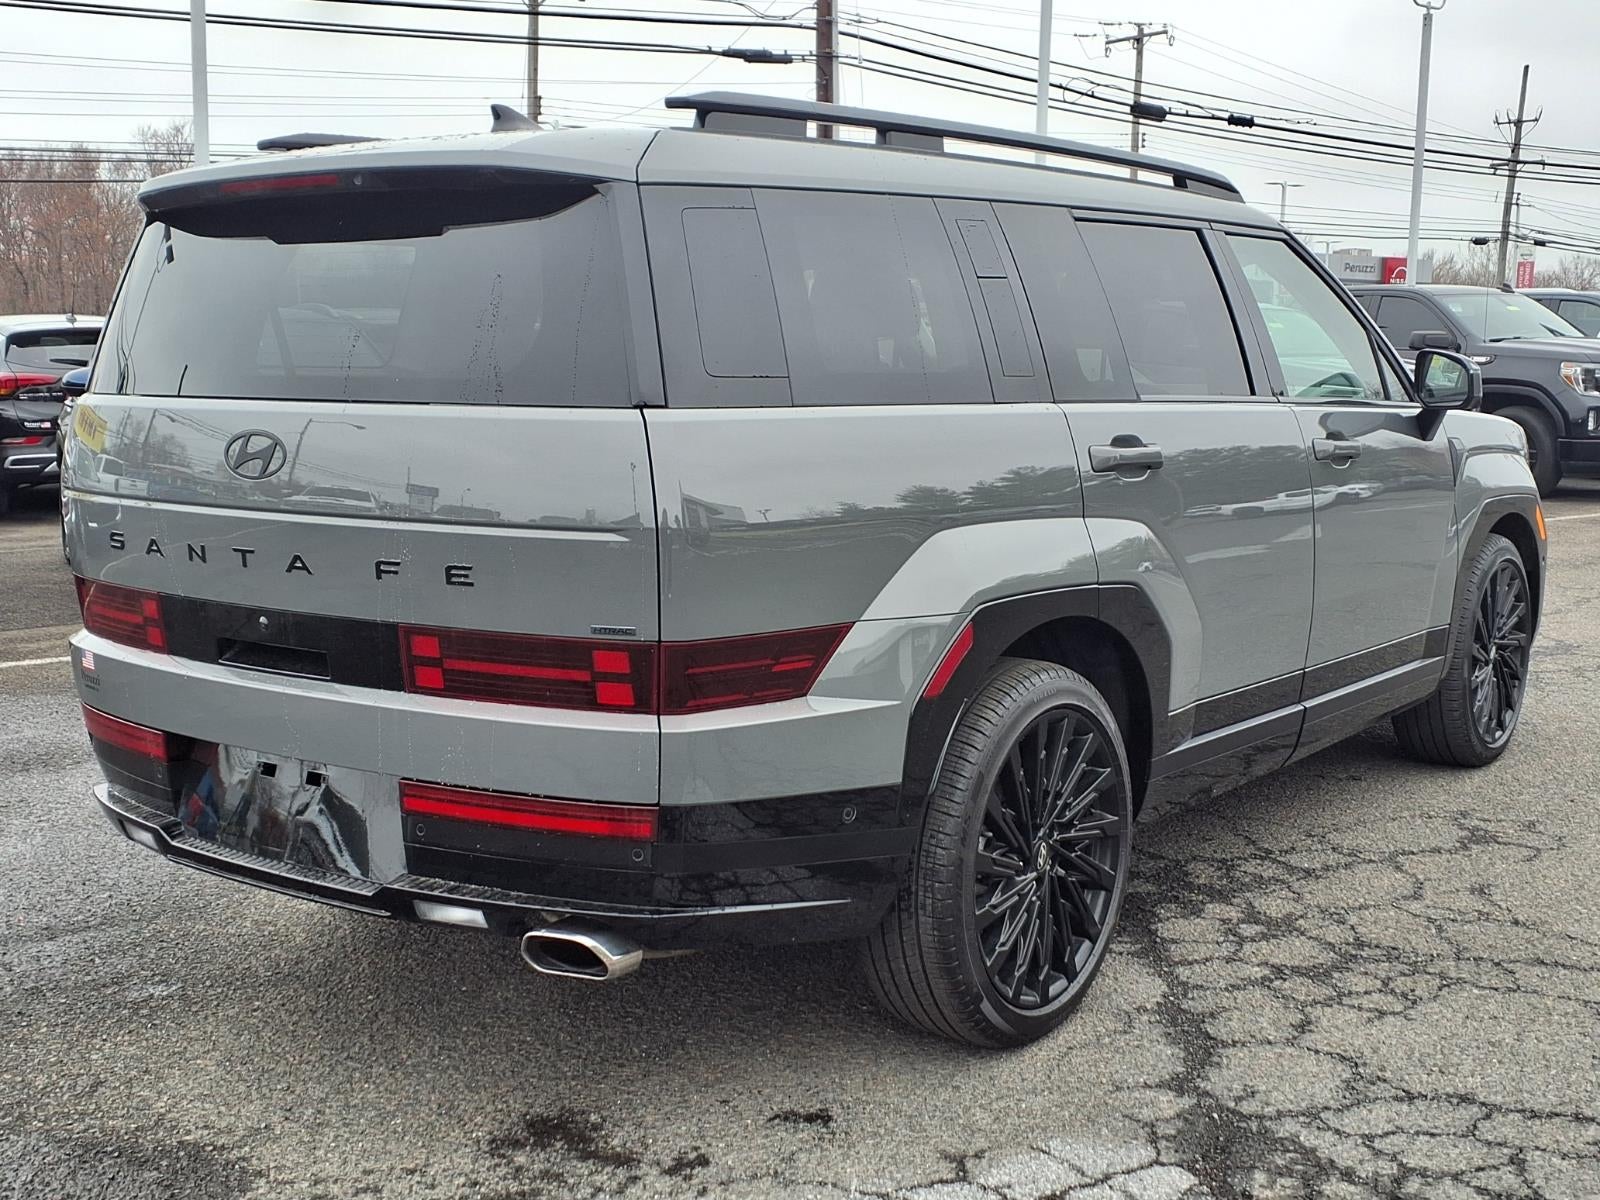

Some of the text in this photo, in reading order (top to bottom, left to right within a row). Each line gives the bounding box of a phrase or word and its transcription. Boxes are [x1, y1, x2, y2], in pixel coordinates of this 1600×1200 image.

[1344, 262, 1377, 273] Peruzzi
[110, 530, 475, 587] SANTA FE
[591, 627, 635, 636] HTRAC
